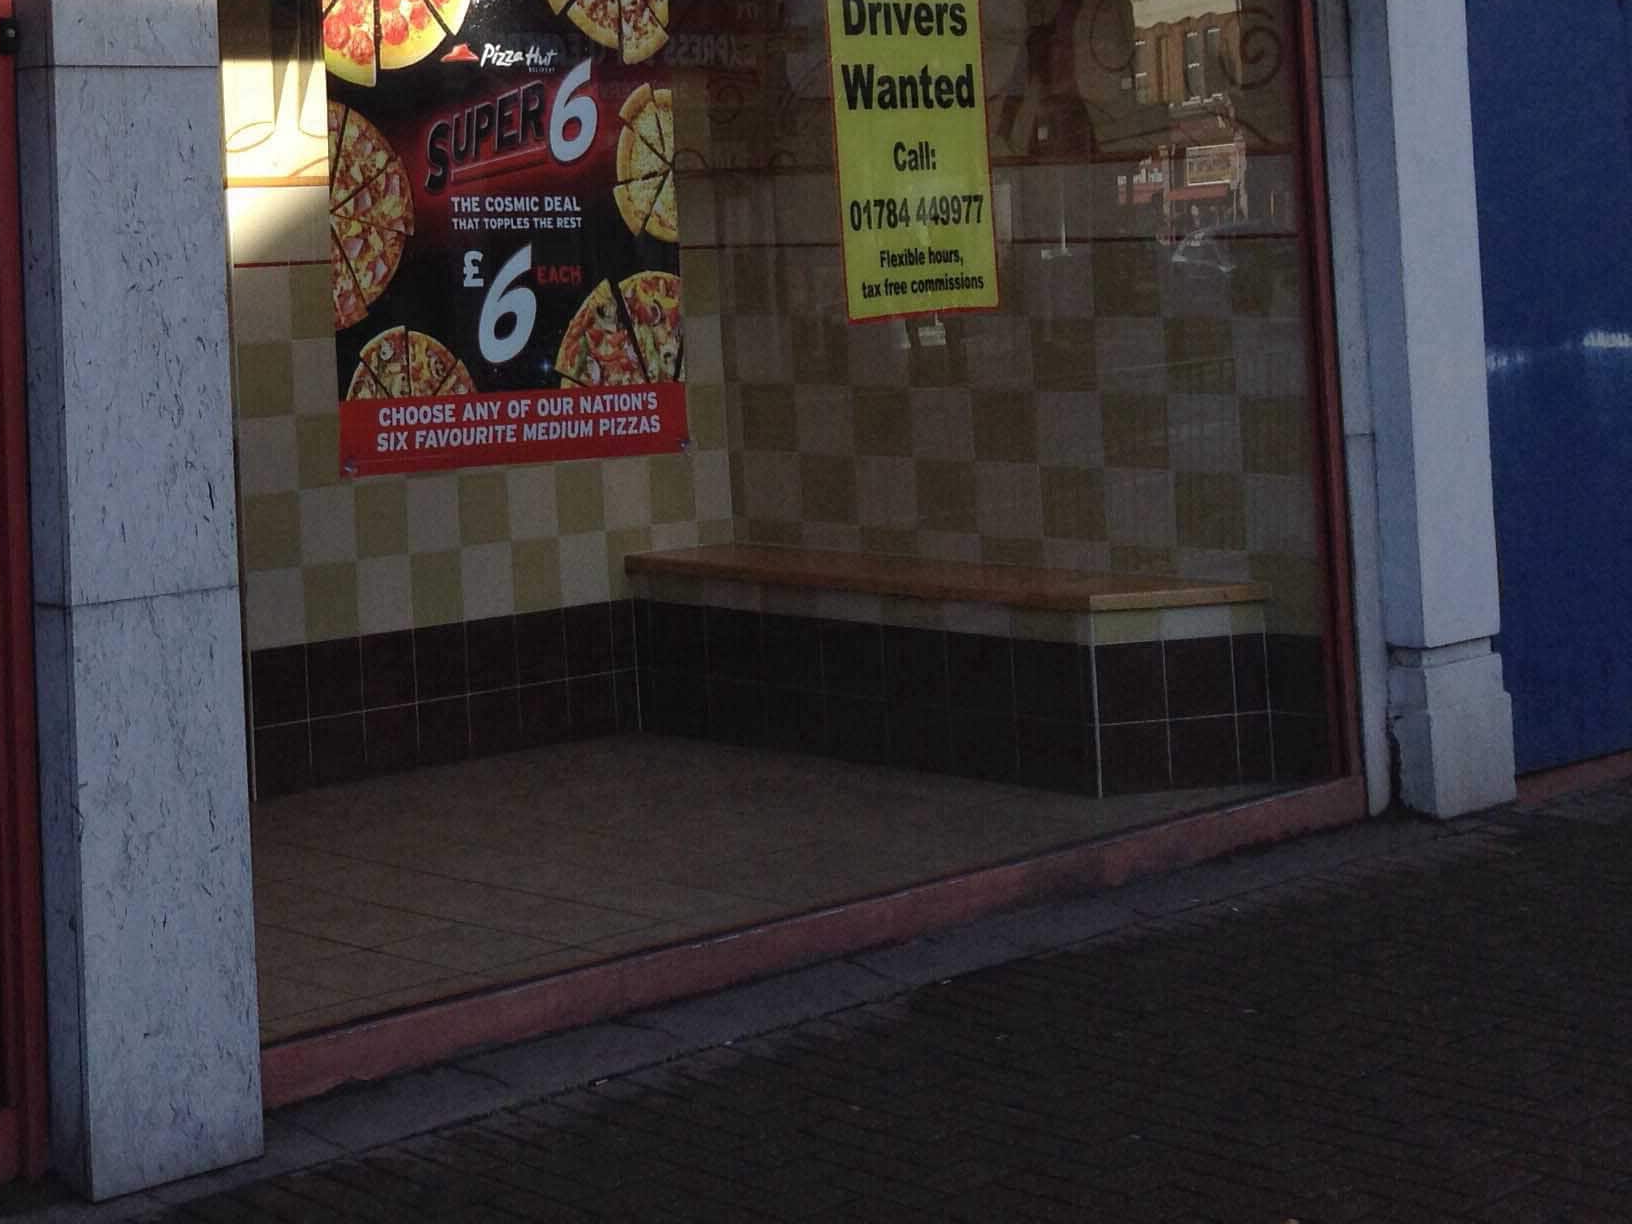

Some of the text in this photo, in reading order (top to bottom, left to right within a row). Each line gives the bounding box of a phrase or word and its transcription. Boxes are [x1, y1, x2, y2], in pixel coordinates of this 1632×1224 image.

[480, 43, 558, 67] Pizza Hut
[841, 63, 976, 110] Wanted
[424, 56, 599, 193] SUPER 6
[893, 140, 937, 172] Call:
[451, 196, 581, 212] THE COSMIC DEAL
[850, 194, 984, 231] 01784 449977
[451, 217, 583, 230] THAT TOPPLES THE REST
[880, 247, 964, 268] Flexible hours,
[536, 266, 583, 285] EACH
[862, 272, 984, 299] tax free commissions
[378, 392, 658, 427] CHOOSE ANY OF OUR NATION'S
[377, 415, 661, 452] SIX FAVOURITE MEDIUM PIZZAS
